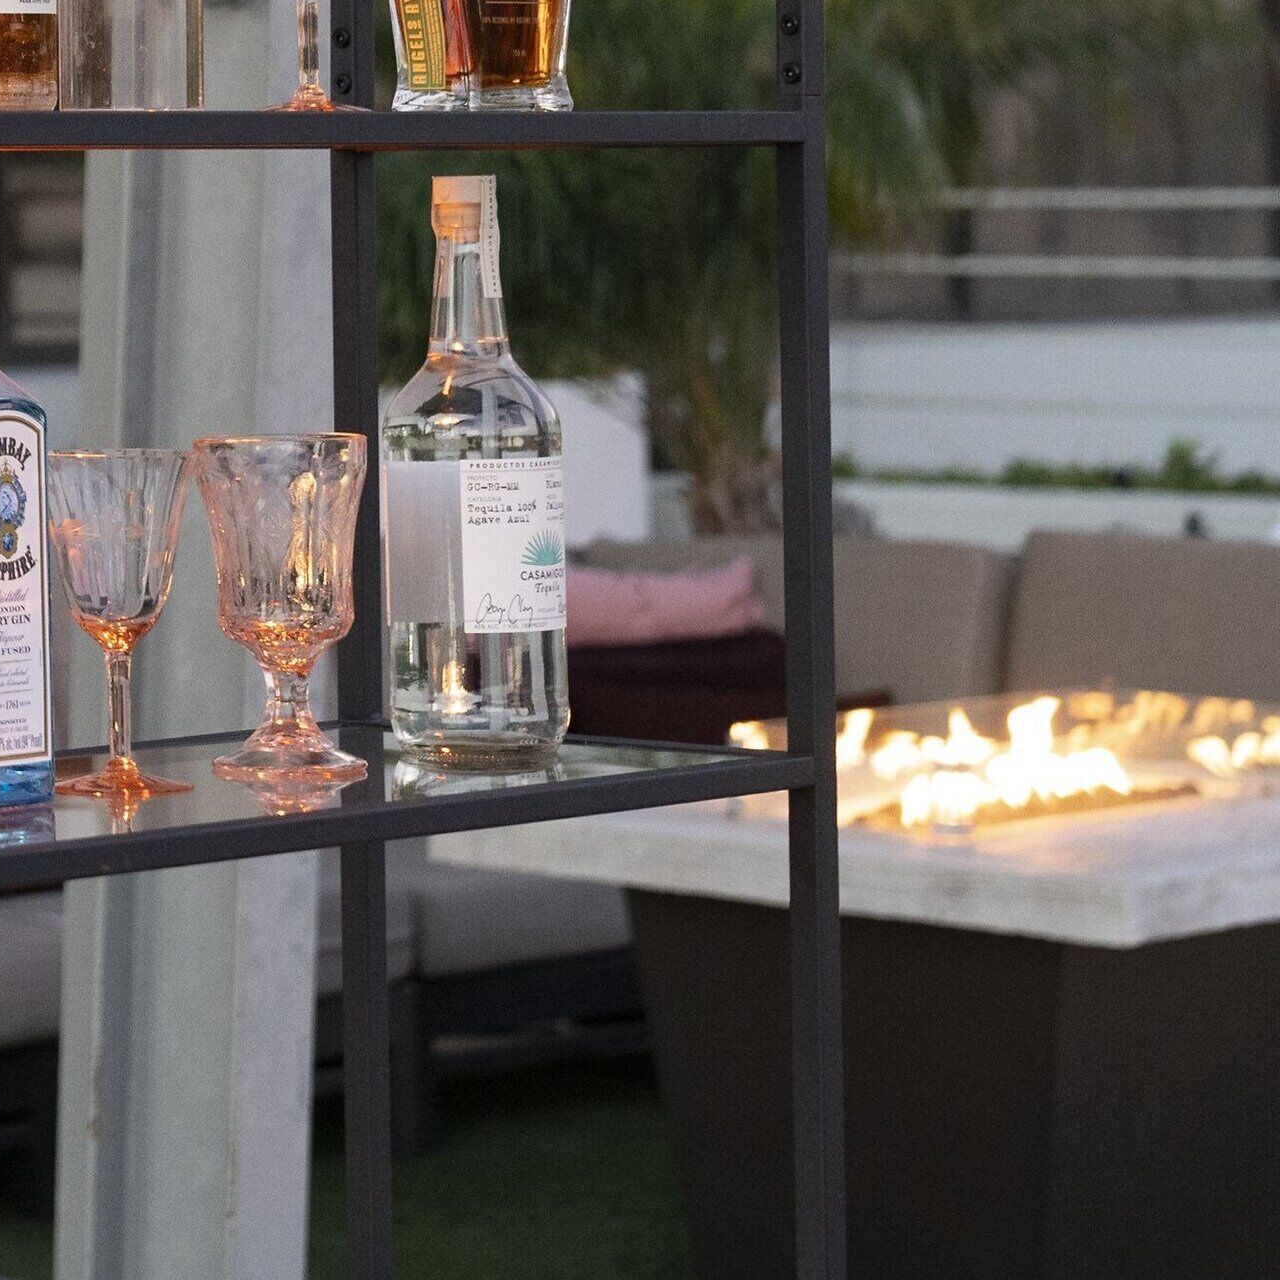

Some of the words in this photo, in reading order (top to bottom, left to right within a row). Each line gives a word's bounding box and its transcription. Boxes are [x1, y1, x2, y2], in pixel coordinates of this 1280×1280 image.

[469, 461, 525, 469] PRODUCTOS
[467, 503, 513, 514] Tequila
[517, 499, 537, 513] 100%
[467, 515, 501, 526] Agave
[507, 515, 531, 523] Azul
[534, 582, 561, 596] Tequila
[11, 614, 31, 625] GIN
[5, 700, 19, 710] 1761
